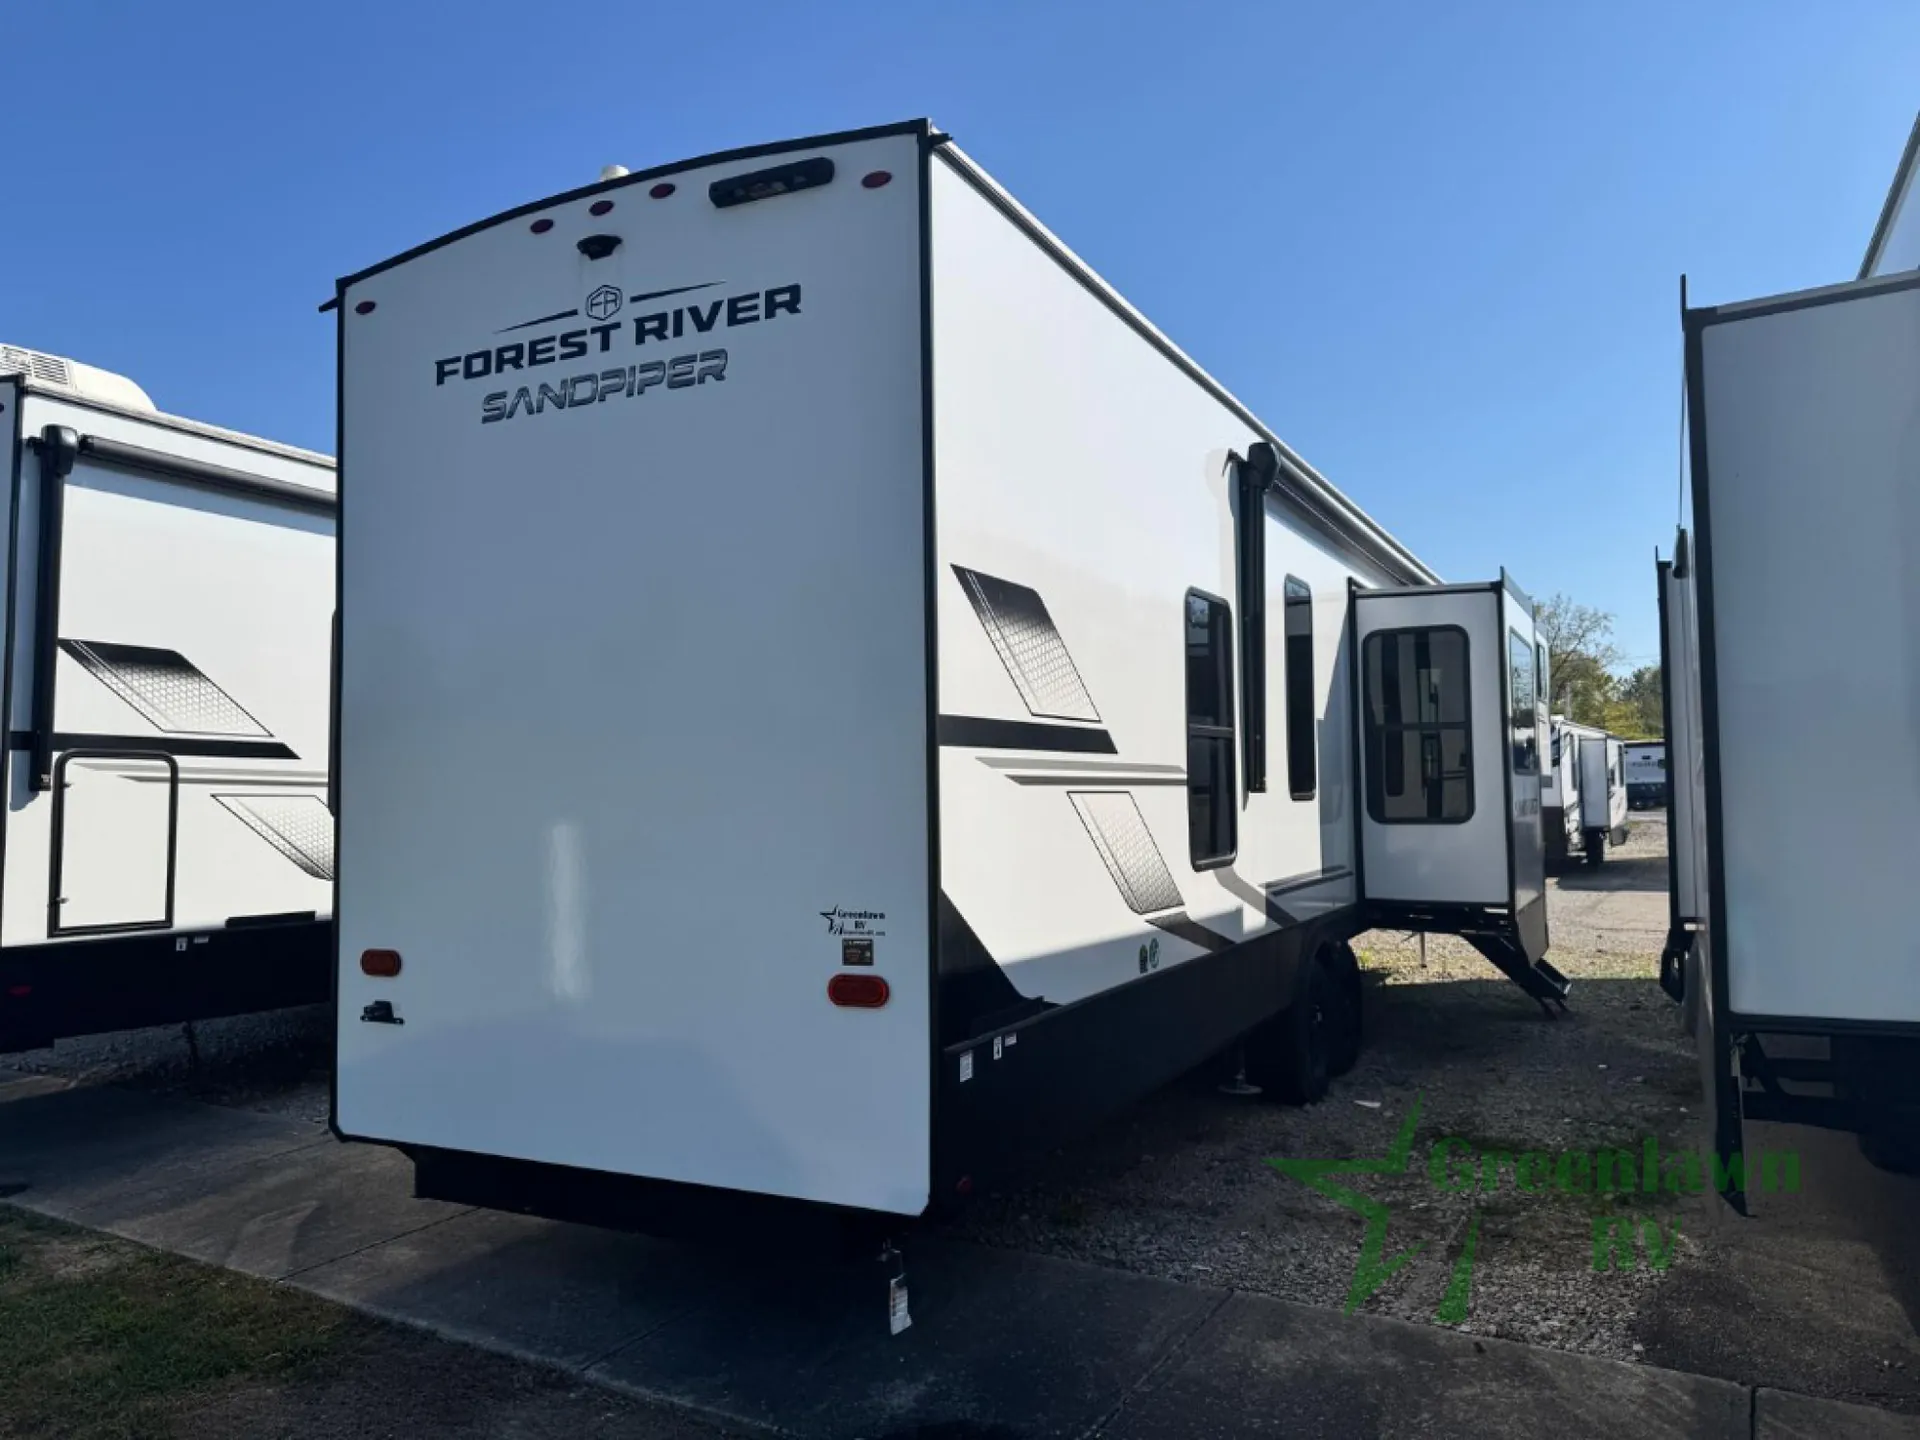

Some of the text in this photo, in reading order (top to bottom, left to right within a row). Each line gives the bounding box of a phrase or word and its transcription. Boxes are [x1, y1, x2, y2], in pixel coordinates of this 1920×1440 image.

[435, 283, 802, 386] FOREST RIVER
[481, 348, 728, 424] SANDPIPER
[838, 909, 886, 919] Greenlawn
